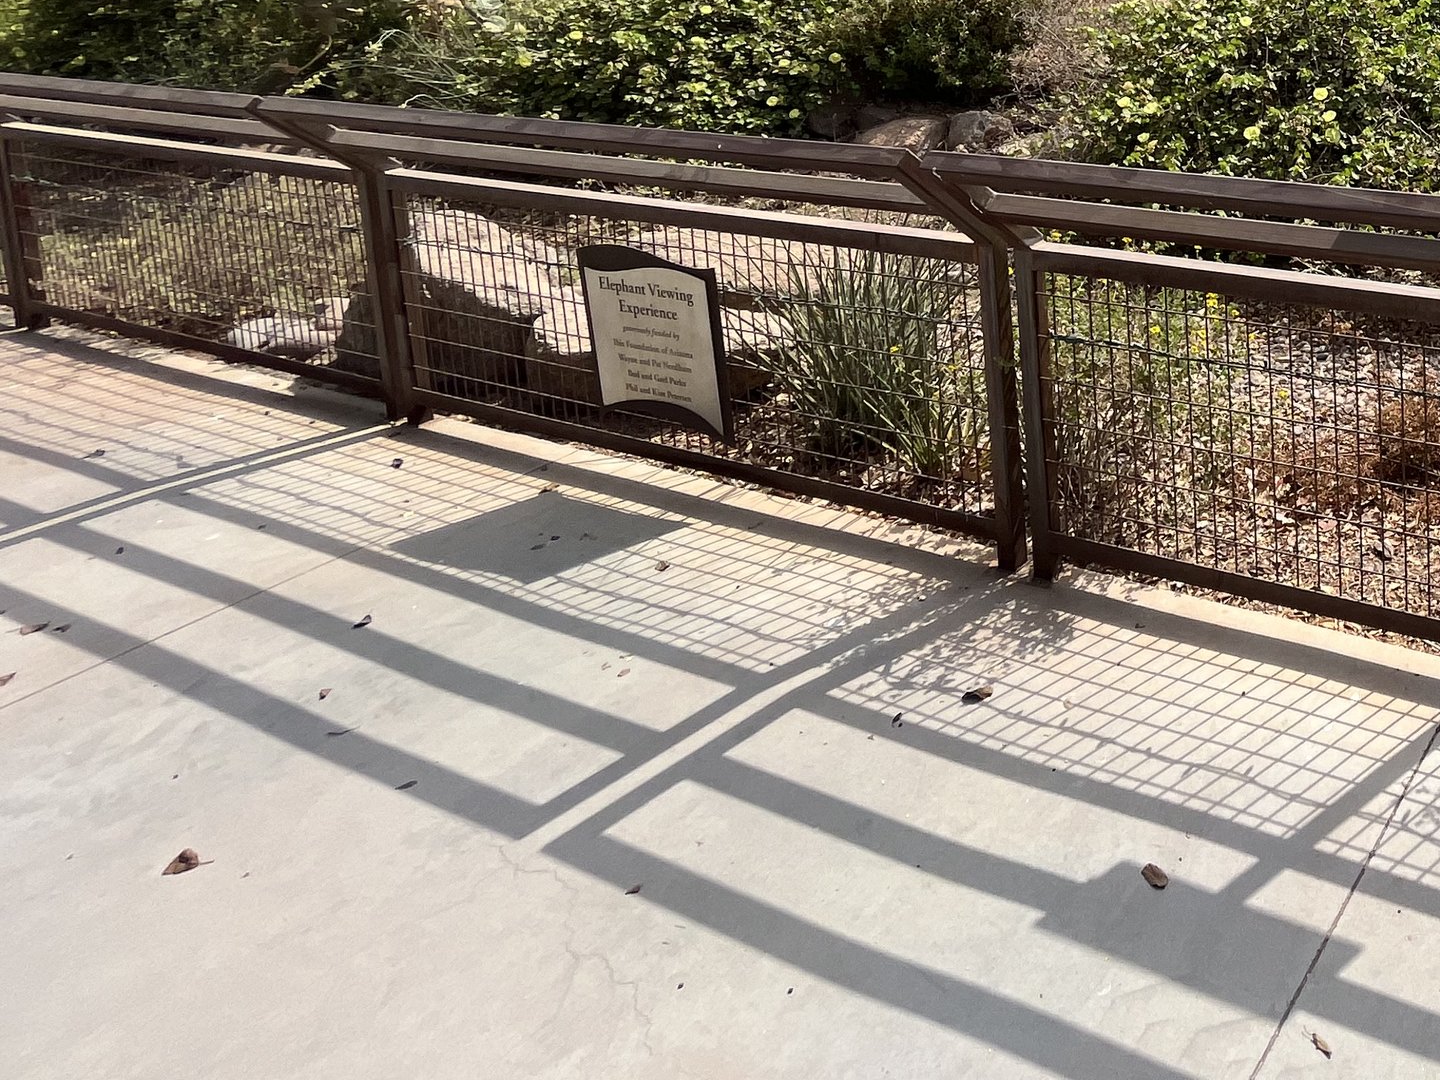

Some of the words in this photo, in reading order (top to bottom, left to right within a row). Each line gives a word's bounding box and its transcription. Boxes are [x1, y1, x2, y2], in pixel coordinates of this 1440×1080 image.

[599, 276, 646, 296] Elephant
[647, 283, 694, 307] Viewing
[619, 299, 678, 320] Experience
[673, 332, 680, 341] by
